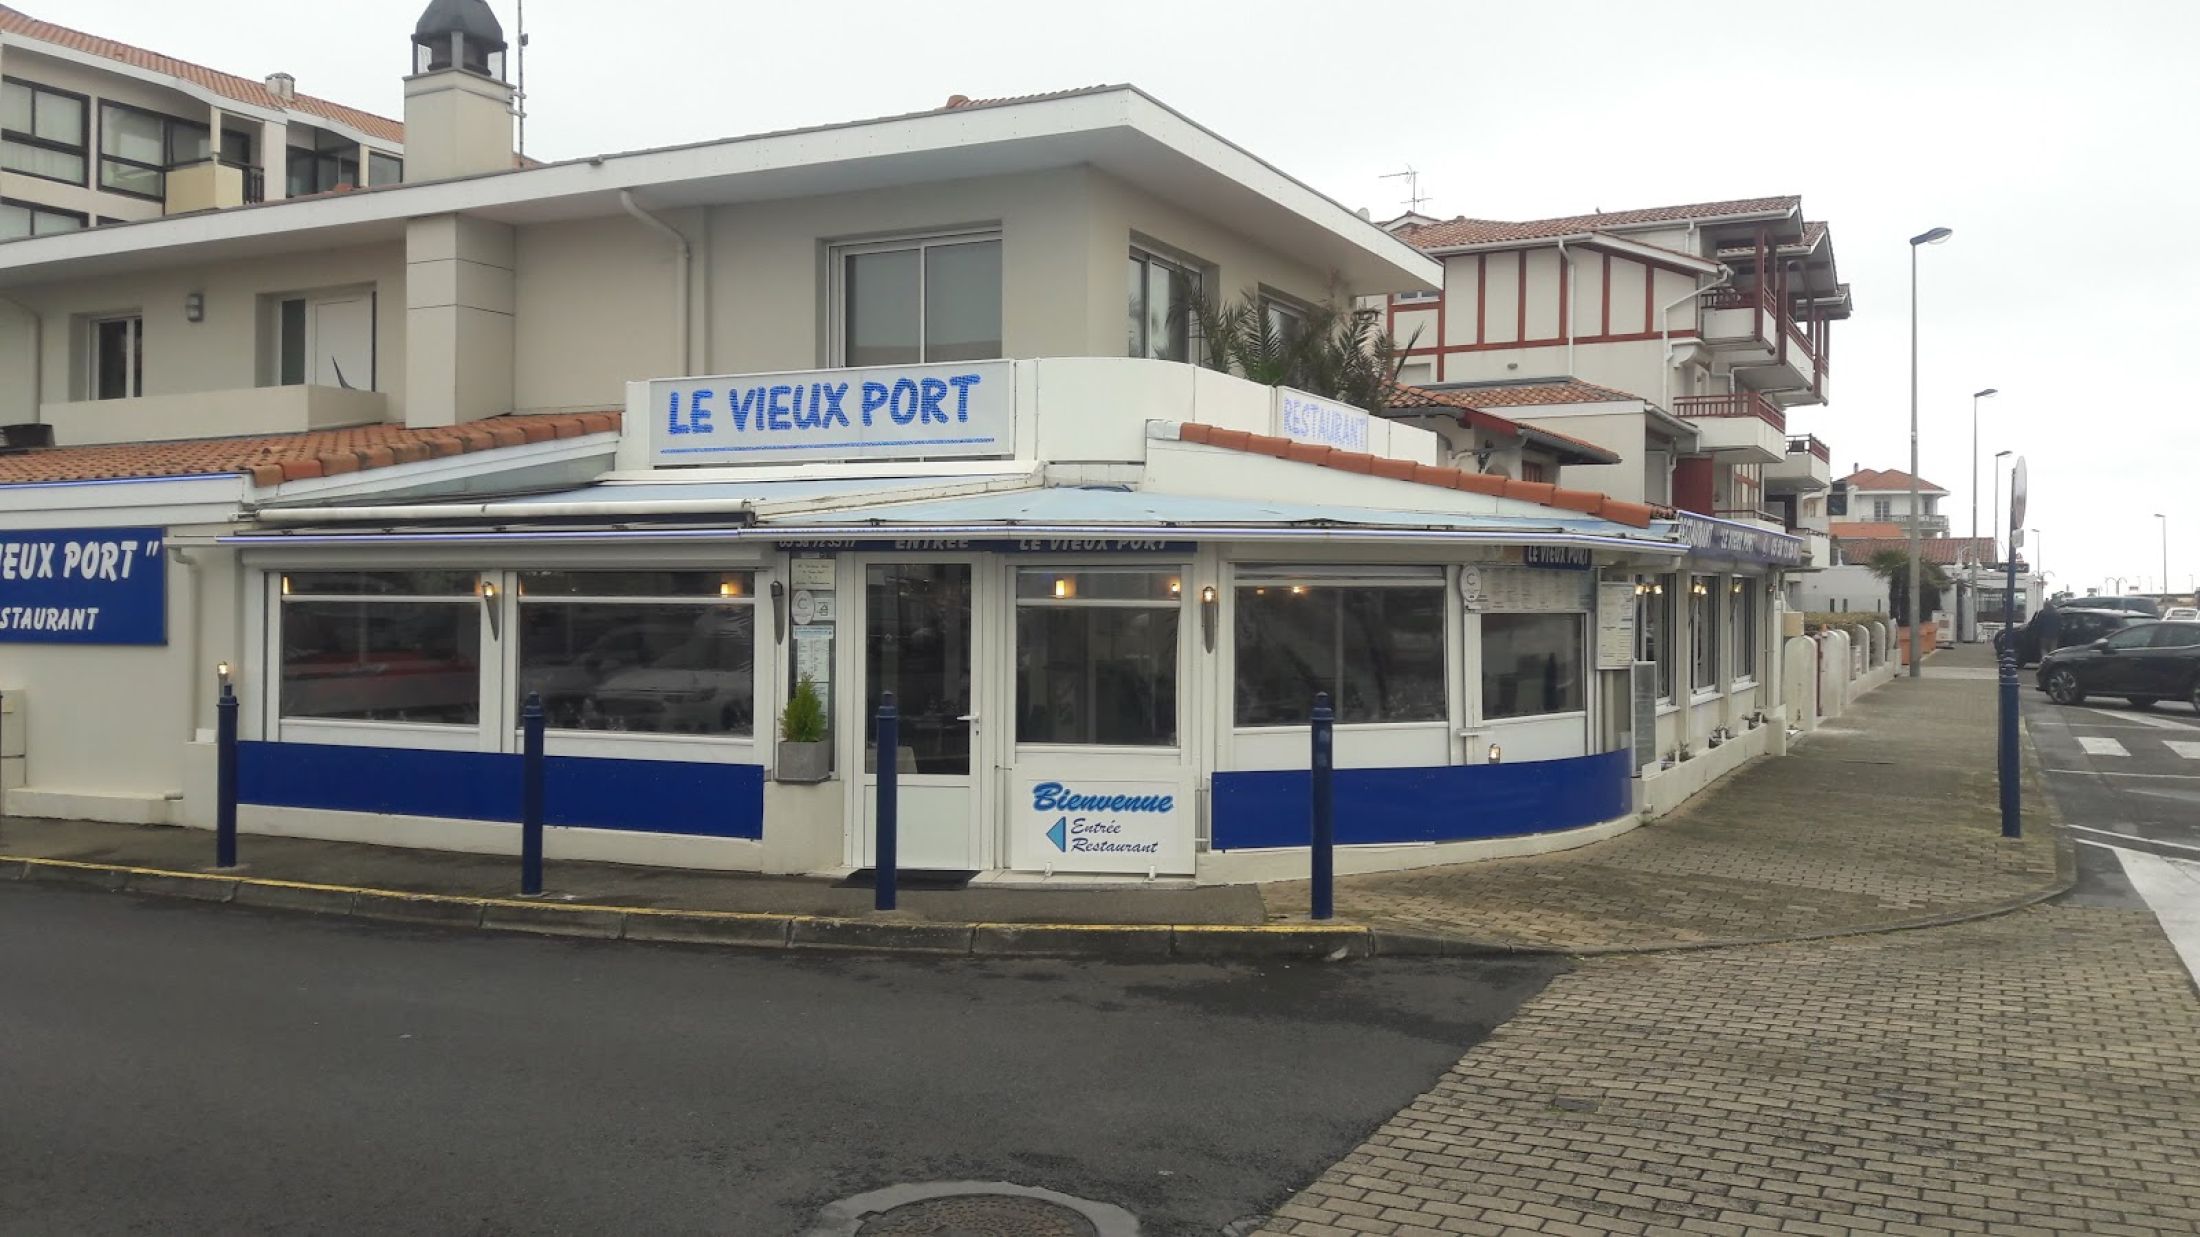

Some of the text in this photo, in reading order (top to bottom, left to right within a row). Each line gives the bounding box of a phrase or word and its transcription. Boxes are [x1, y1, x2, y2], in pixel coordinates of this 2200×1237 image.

[668, 373, 981, 435] LE VIEUX PORT
[1283, 396, 1366, 448] RESTAURANT
[0, 542, 55, 580] EUX
[63, 540, 138, 582] PORT
[1032, 781, 1174, 813] Bienvenue
[1070, 817, 1122, 834] Entrée
[1071, 838, 1158, 853] Restaurant
